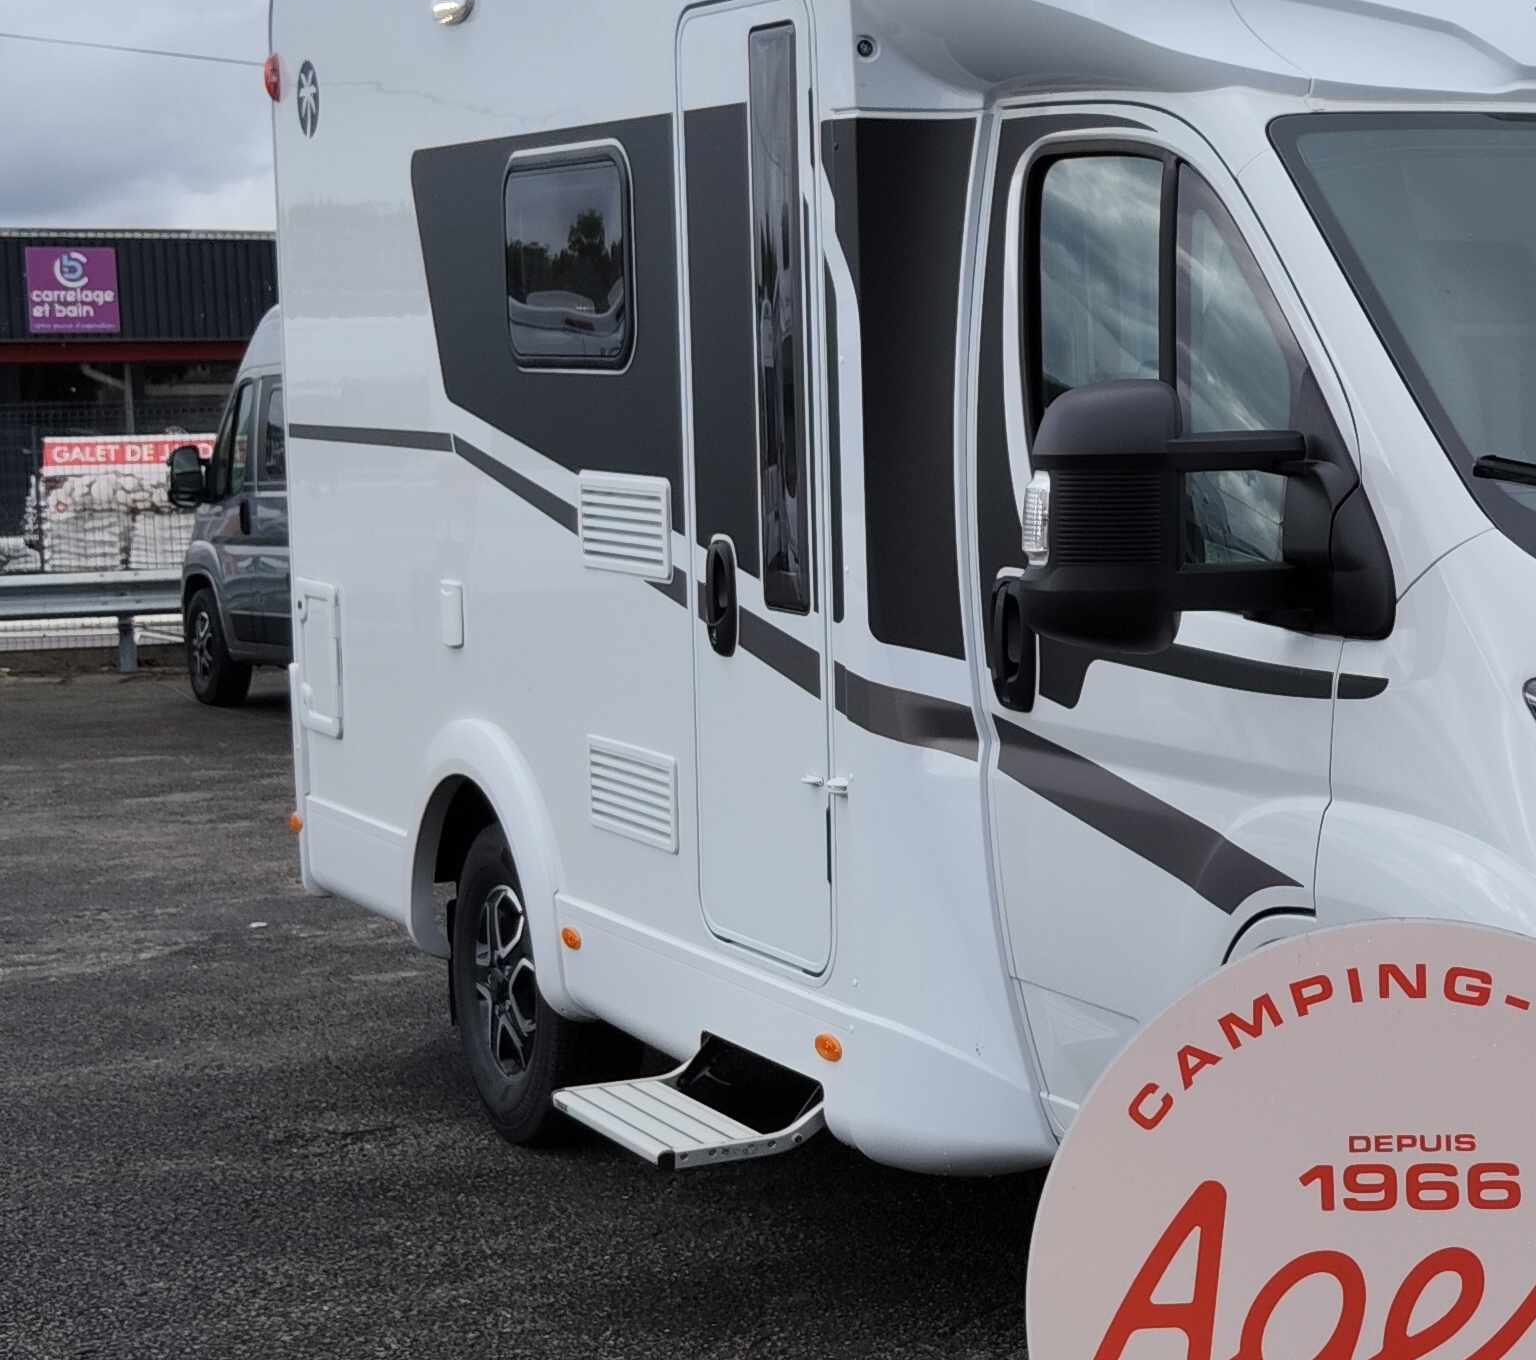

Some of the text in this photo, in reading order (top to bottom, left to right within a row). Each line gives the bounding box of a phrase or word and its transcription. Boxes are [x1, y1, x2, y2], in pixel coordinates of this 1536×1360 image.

[31, 288, 114, 306] carrelage
[32, 303, 95, 318] et bain
[52, 444, 119, 463] GALET
[125, 444, 154, 462] DE
[1348, 1133, 1477, 1153] DEPUIS
[1299, 1161, 1522, 1212] 1966
